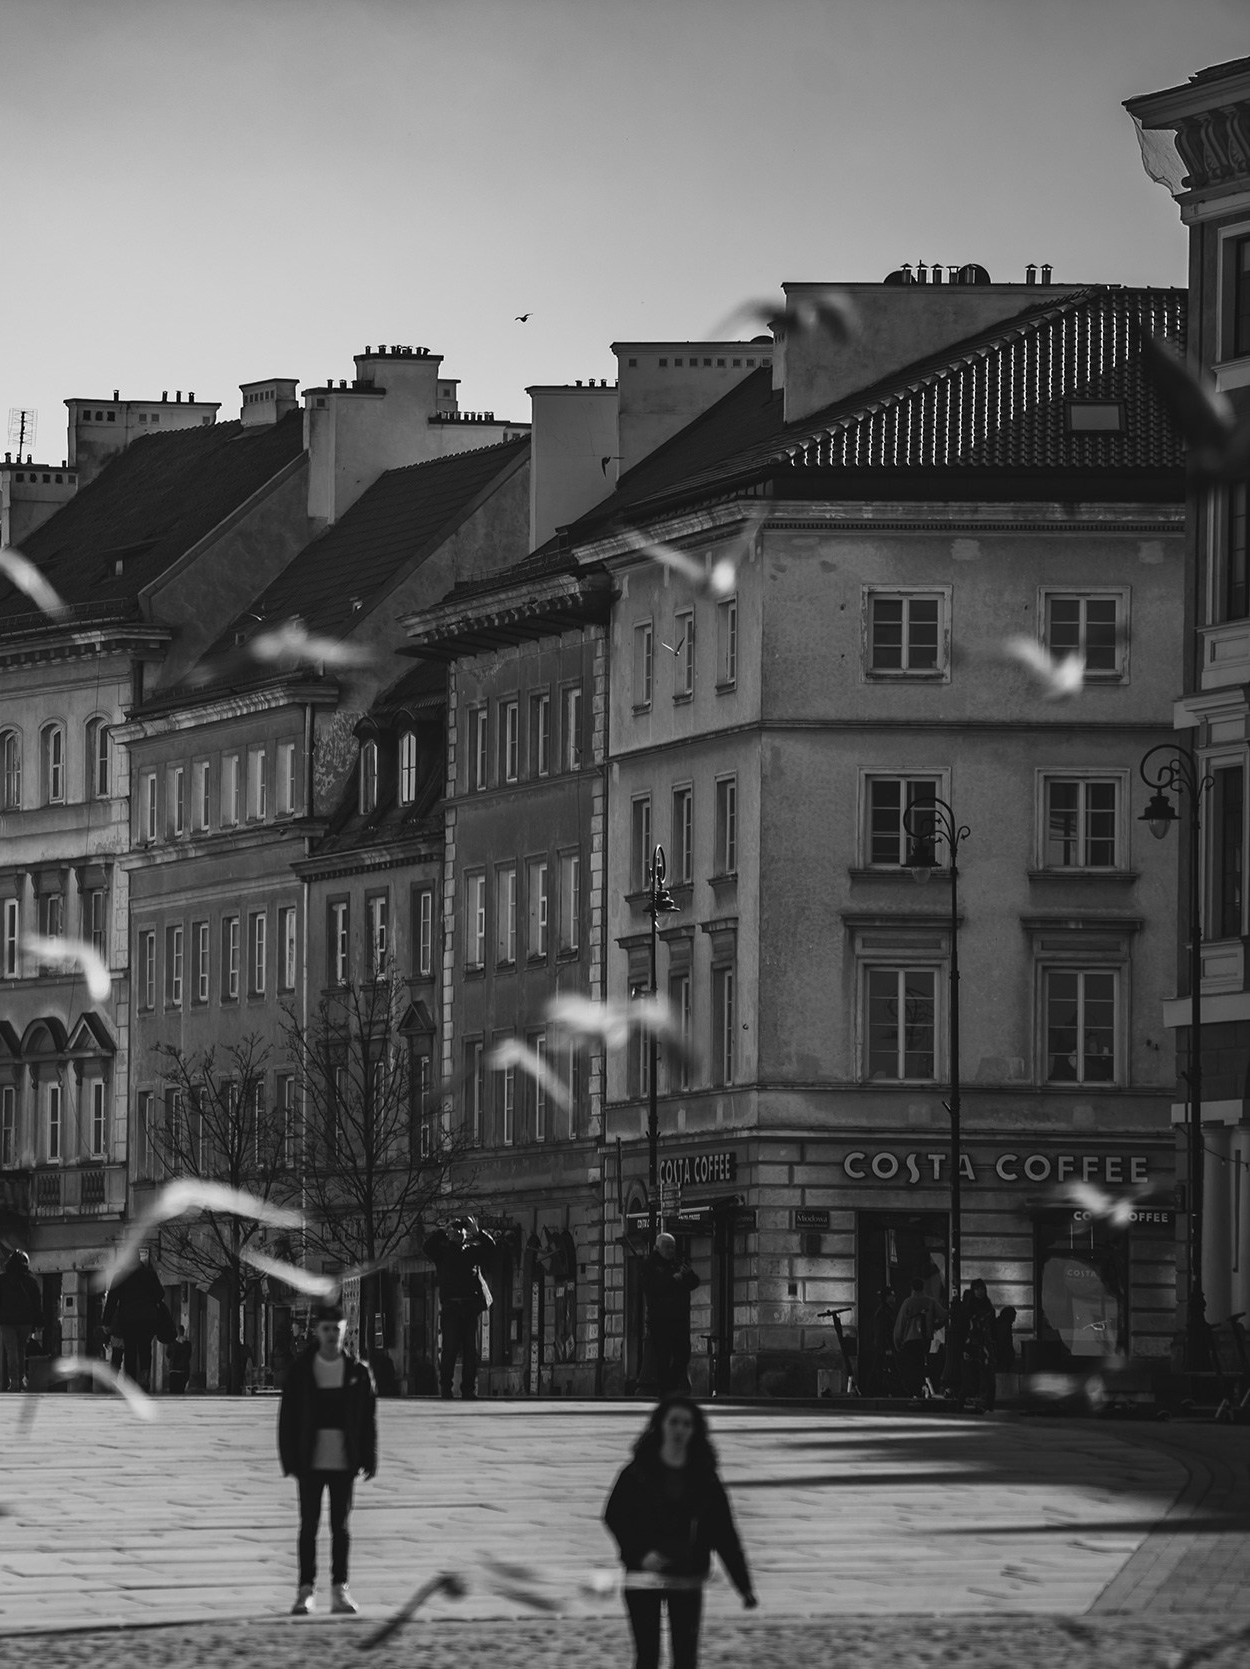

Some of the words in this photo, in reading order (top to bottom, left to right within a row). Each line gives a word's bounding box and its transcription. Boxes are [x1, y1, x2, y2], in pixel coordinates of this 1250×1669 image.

[660, 1158, 690, 1184] COSTA
[694, 1153, 730, 1182] COFFEE
[843, 1151, 976, 1184] COSTA
[995, 1153, 1149, 1183] COFFEE
[796, 1213, 828, 1223] Miodowa
[1127, 1211, 1168, 1222] OFFEE
[1067, 1269, 1097, 1278] COSTA
